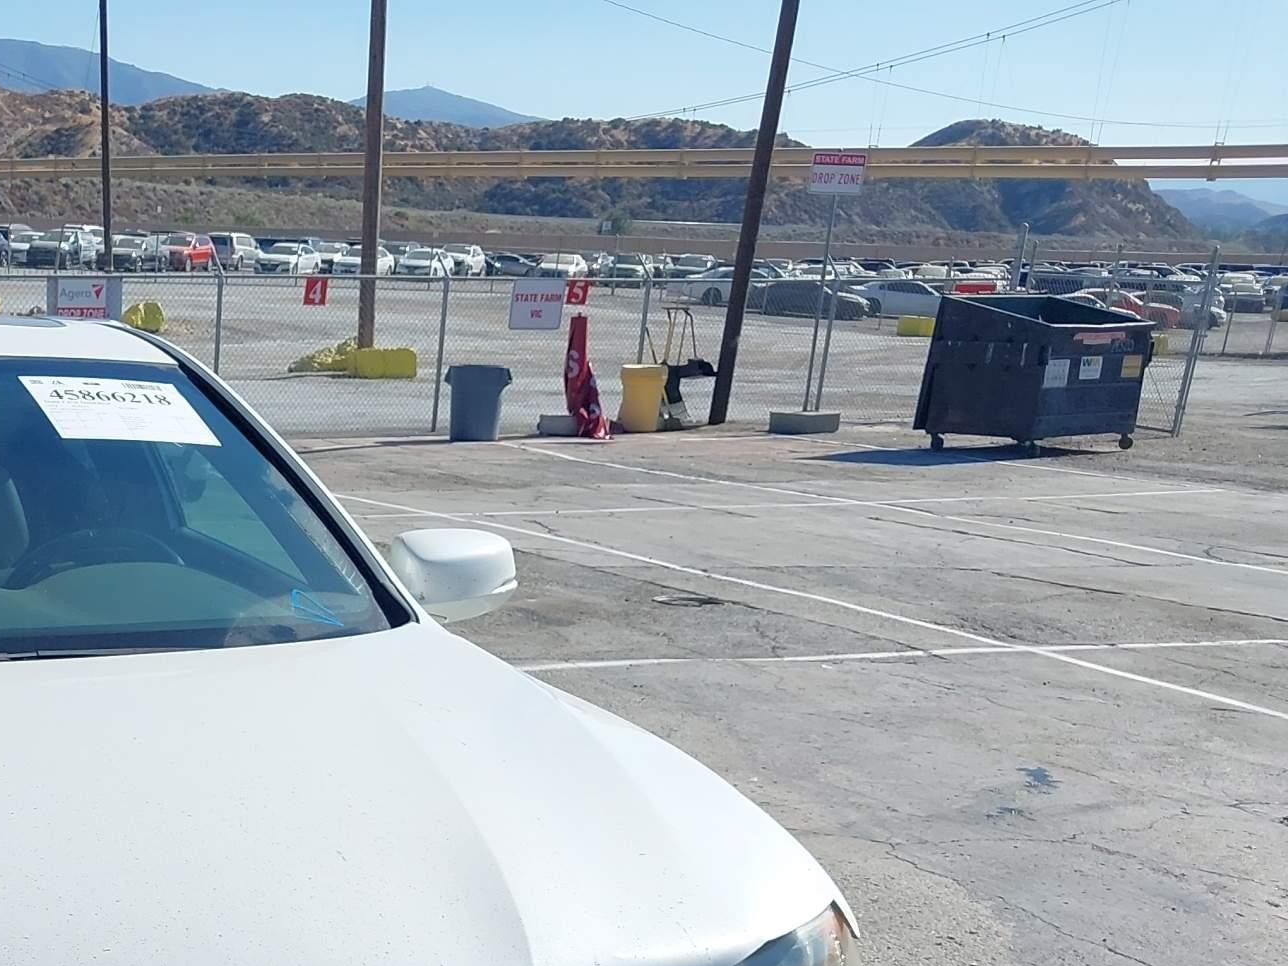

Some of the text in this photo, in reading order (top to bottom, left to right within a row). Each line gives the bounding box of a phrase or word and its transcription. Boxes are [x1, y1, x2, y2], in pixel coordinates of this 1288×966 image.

[816, 155, 838, 165] STATE
[812, 172, 860, 185] DROP ZONE
[60, 288, 91, 300] Agero
[309, 280, 322, 303] 4
[515, 293, 562, 303] STATE FARM
[571, 281, 584, 303] 5
[49, 388, 172, 406] 45866218
